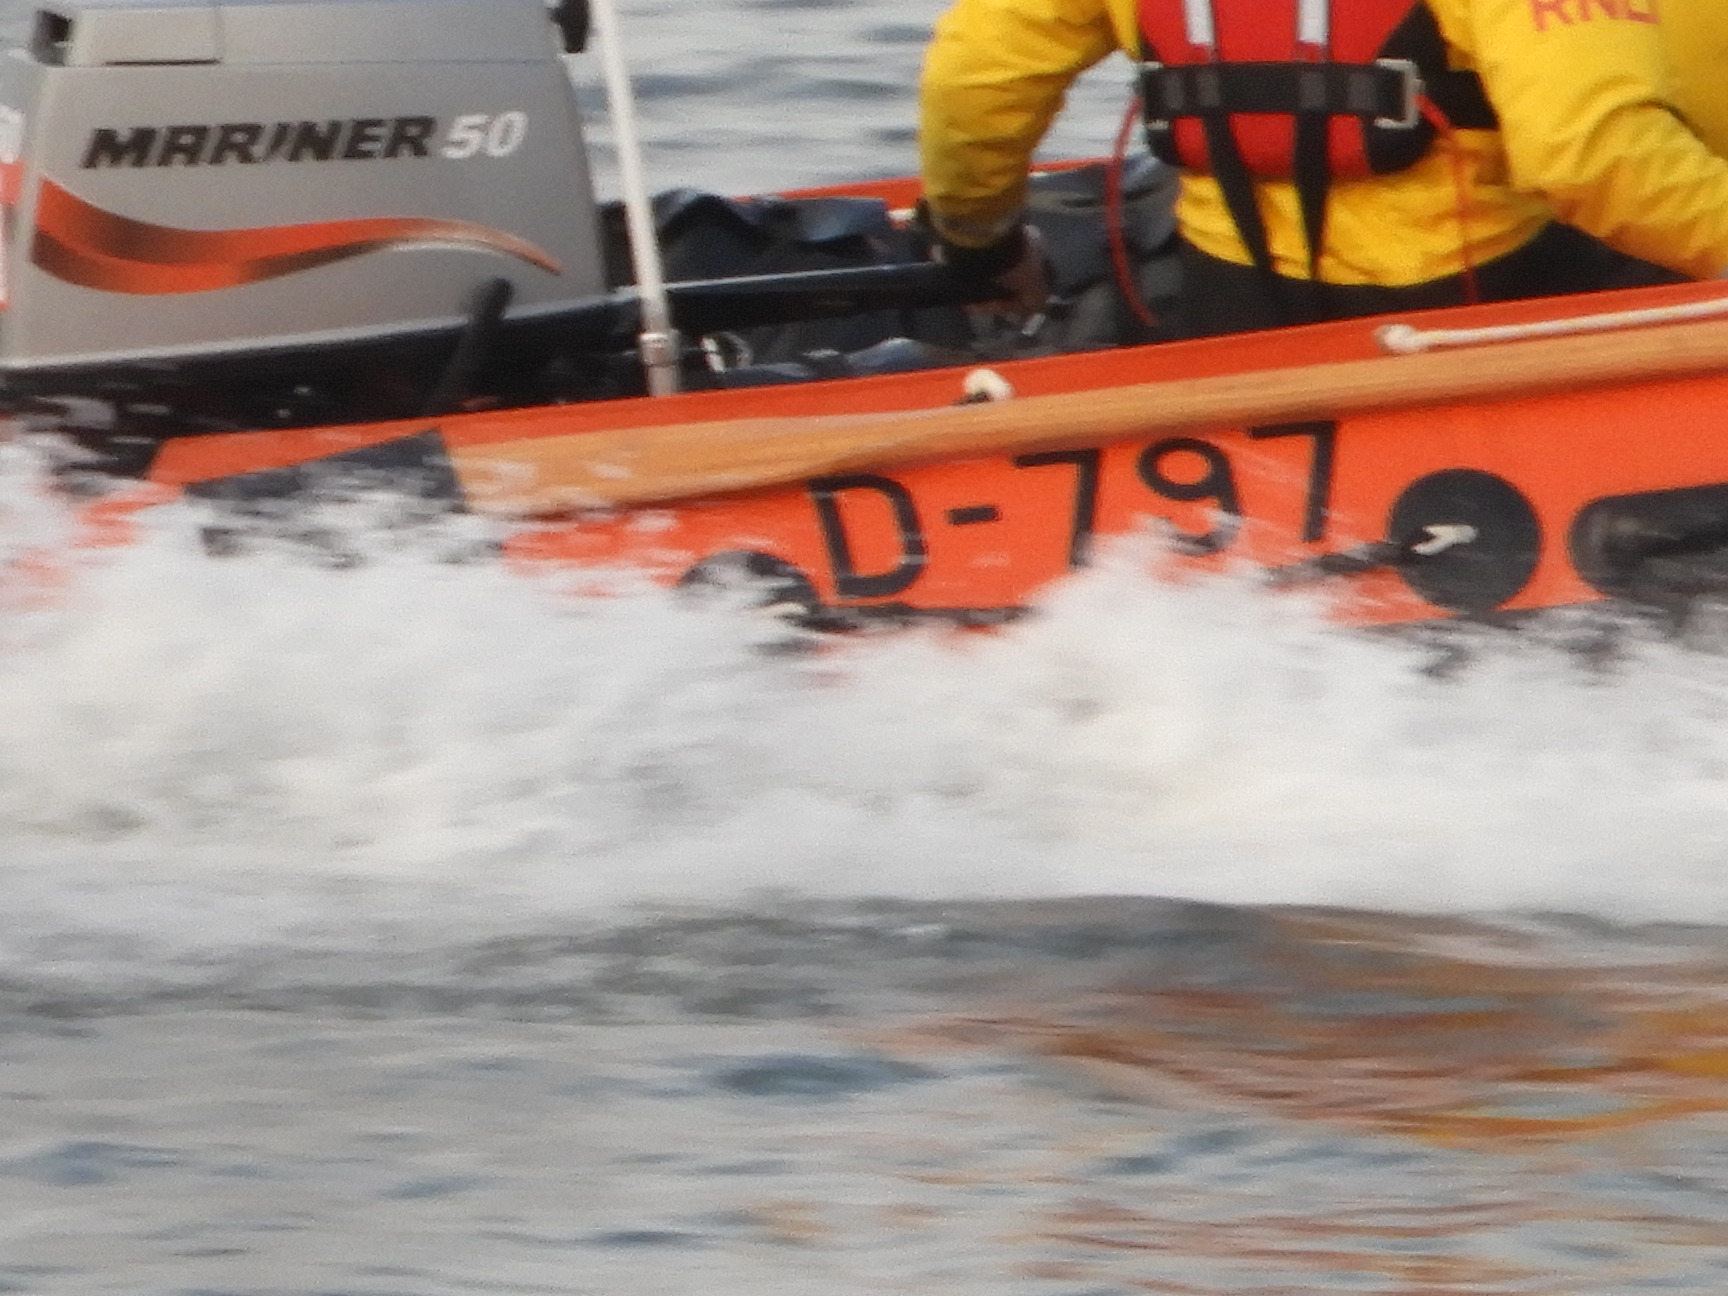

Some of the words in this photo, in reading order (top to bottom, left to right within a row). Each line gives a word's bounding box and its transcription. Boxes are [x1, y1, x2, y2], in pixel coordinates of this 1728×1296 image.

[80, 115, 437, 170] MARINER
[440, 110, 529, 161] 50
[806, 419, 1340, 599] D-797
